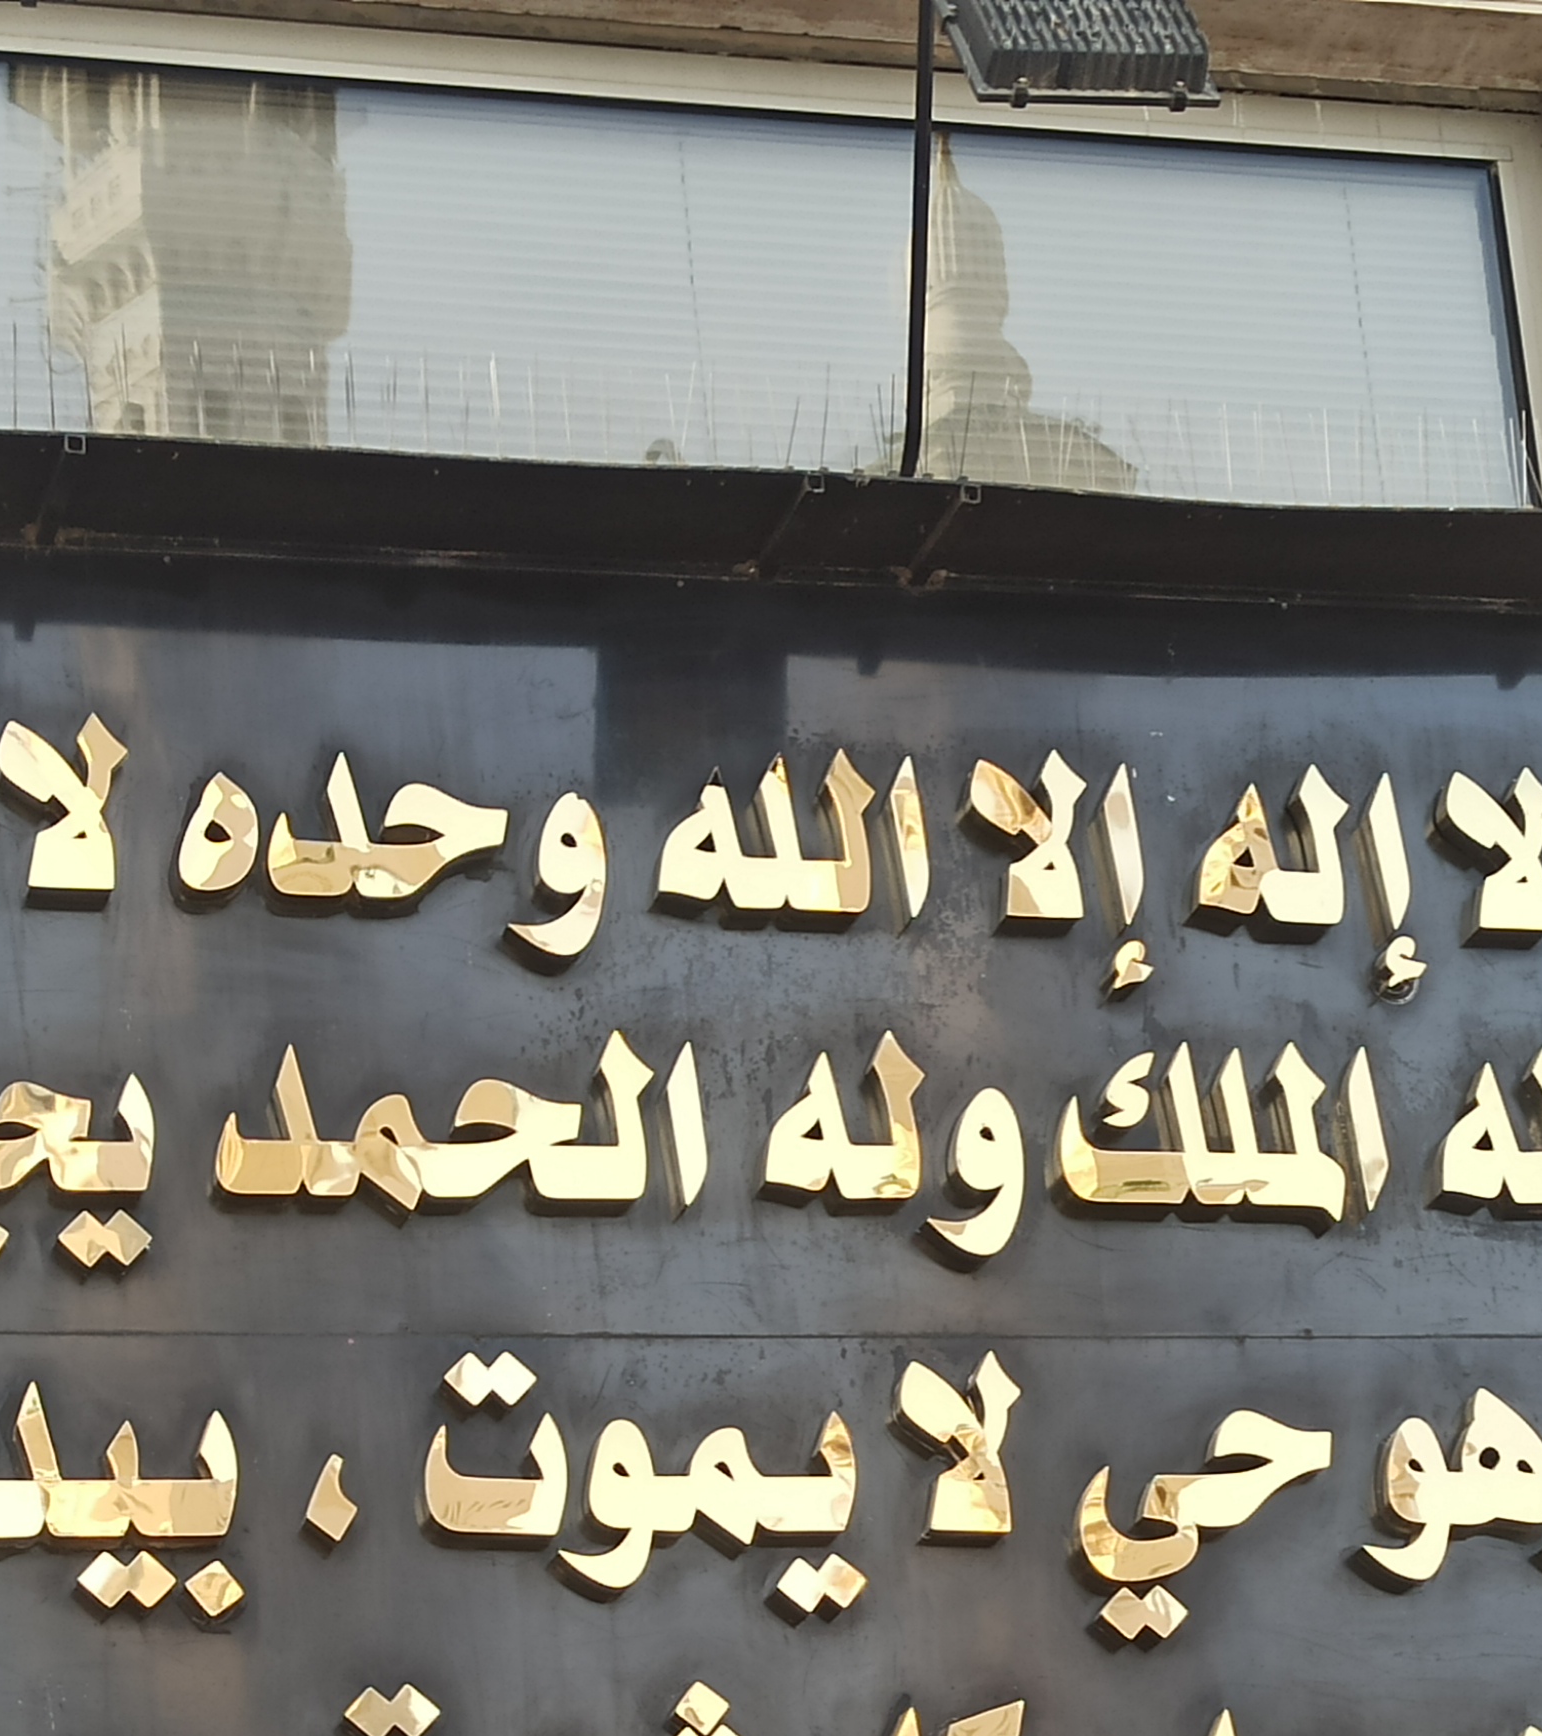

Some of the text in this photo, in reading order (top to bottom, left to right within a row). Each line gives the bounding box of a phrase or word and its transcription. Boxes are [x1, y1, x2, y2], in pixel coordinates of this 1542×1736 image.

[171, 750, 607, 975] وحده
[654, 745, 931, 933] الله
[957, 748, 1156, 1003] إلا
[1184, 762, 1429, 1003] إله
[211, 1028, 709, 1228] الحمد
[759, 1028, 1026, 1273] وله
[1056, 1038, 1391, 1237] الملك
[422, 1348, 869, 1626] يموت
[889, 1348, 1024, 1543] لا
[1071, 1408, 1332, 1648] حي
